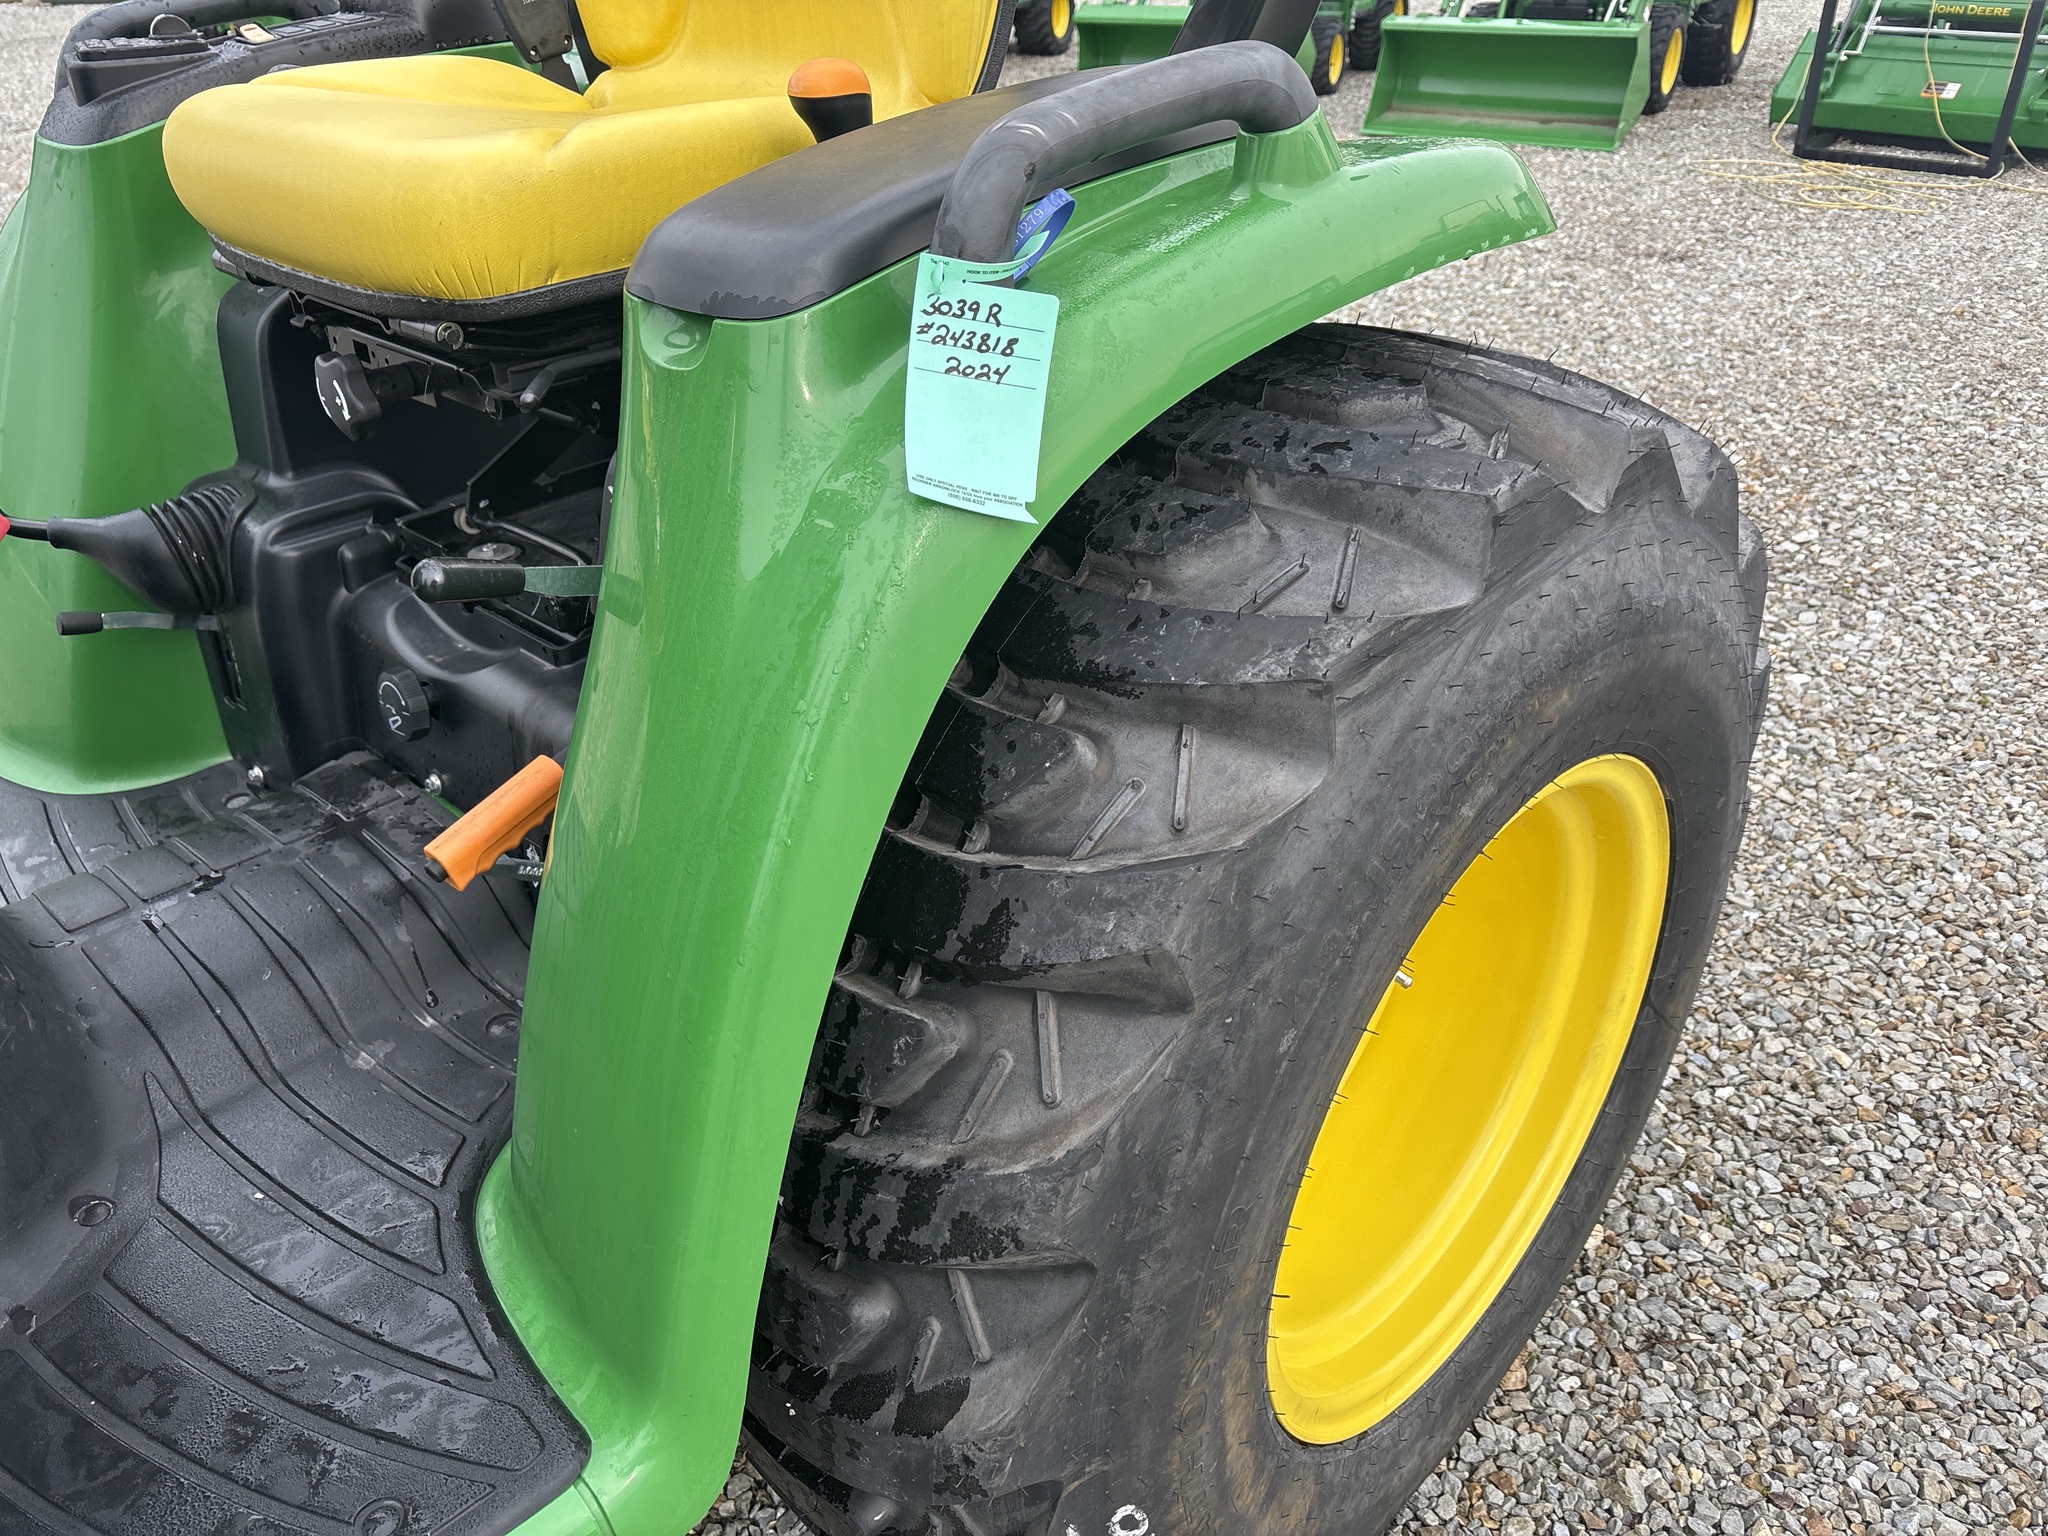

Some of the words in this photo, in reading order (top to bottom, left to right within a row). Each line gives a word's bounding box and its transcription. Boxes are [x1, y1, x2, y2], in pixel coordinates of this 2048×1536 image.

[1933, 3, 1965, 15] JOHN
[1967, 4, 2012, 17] DEERE
[916, 322, 1019, 357] #243818
[944, 356, 1011, 385] 2024
[937, 479, 955, 489] SPECIAL
